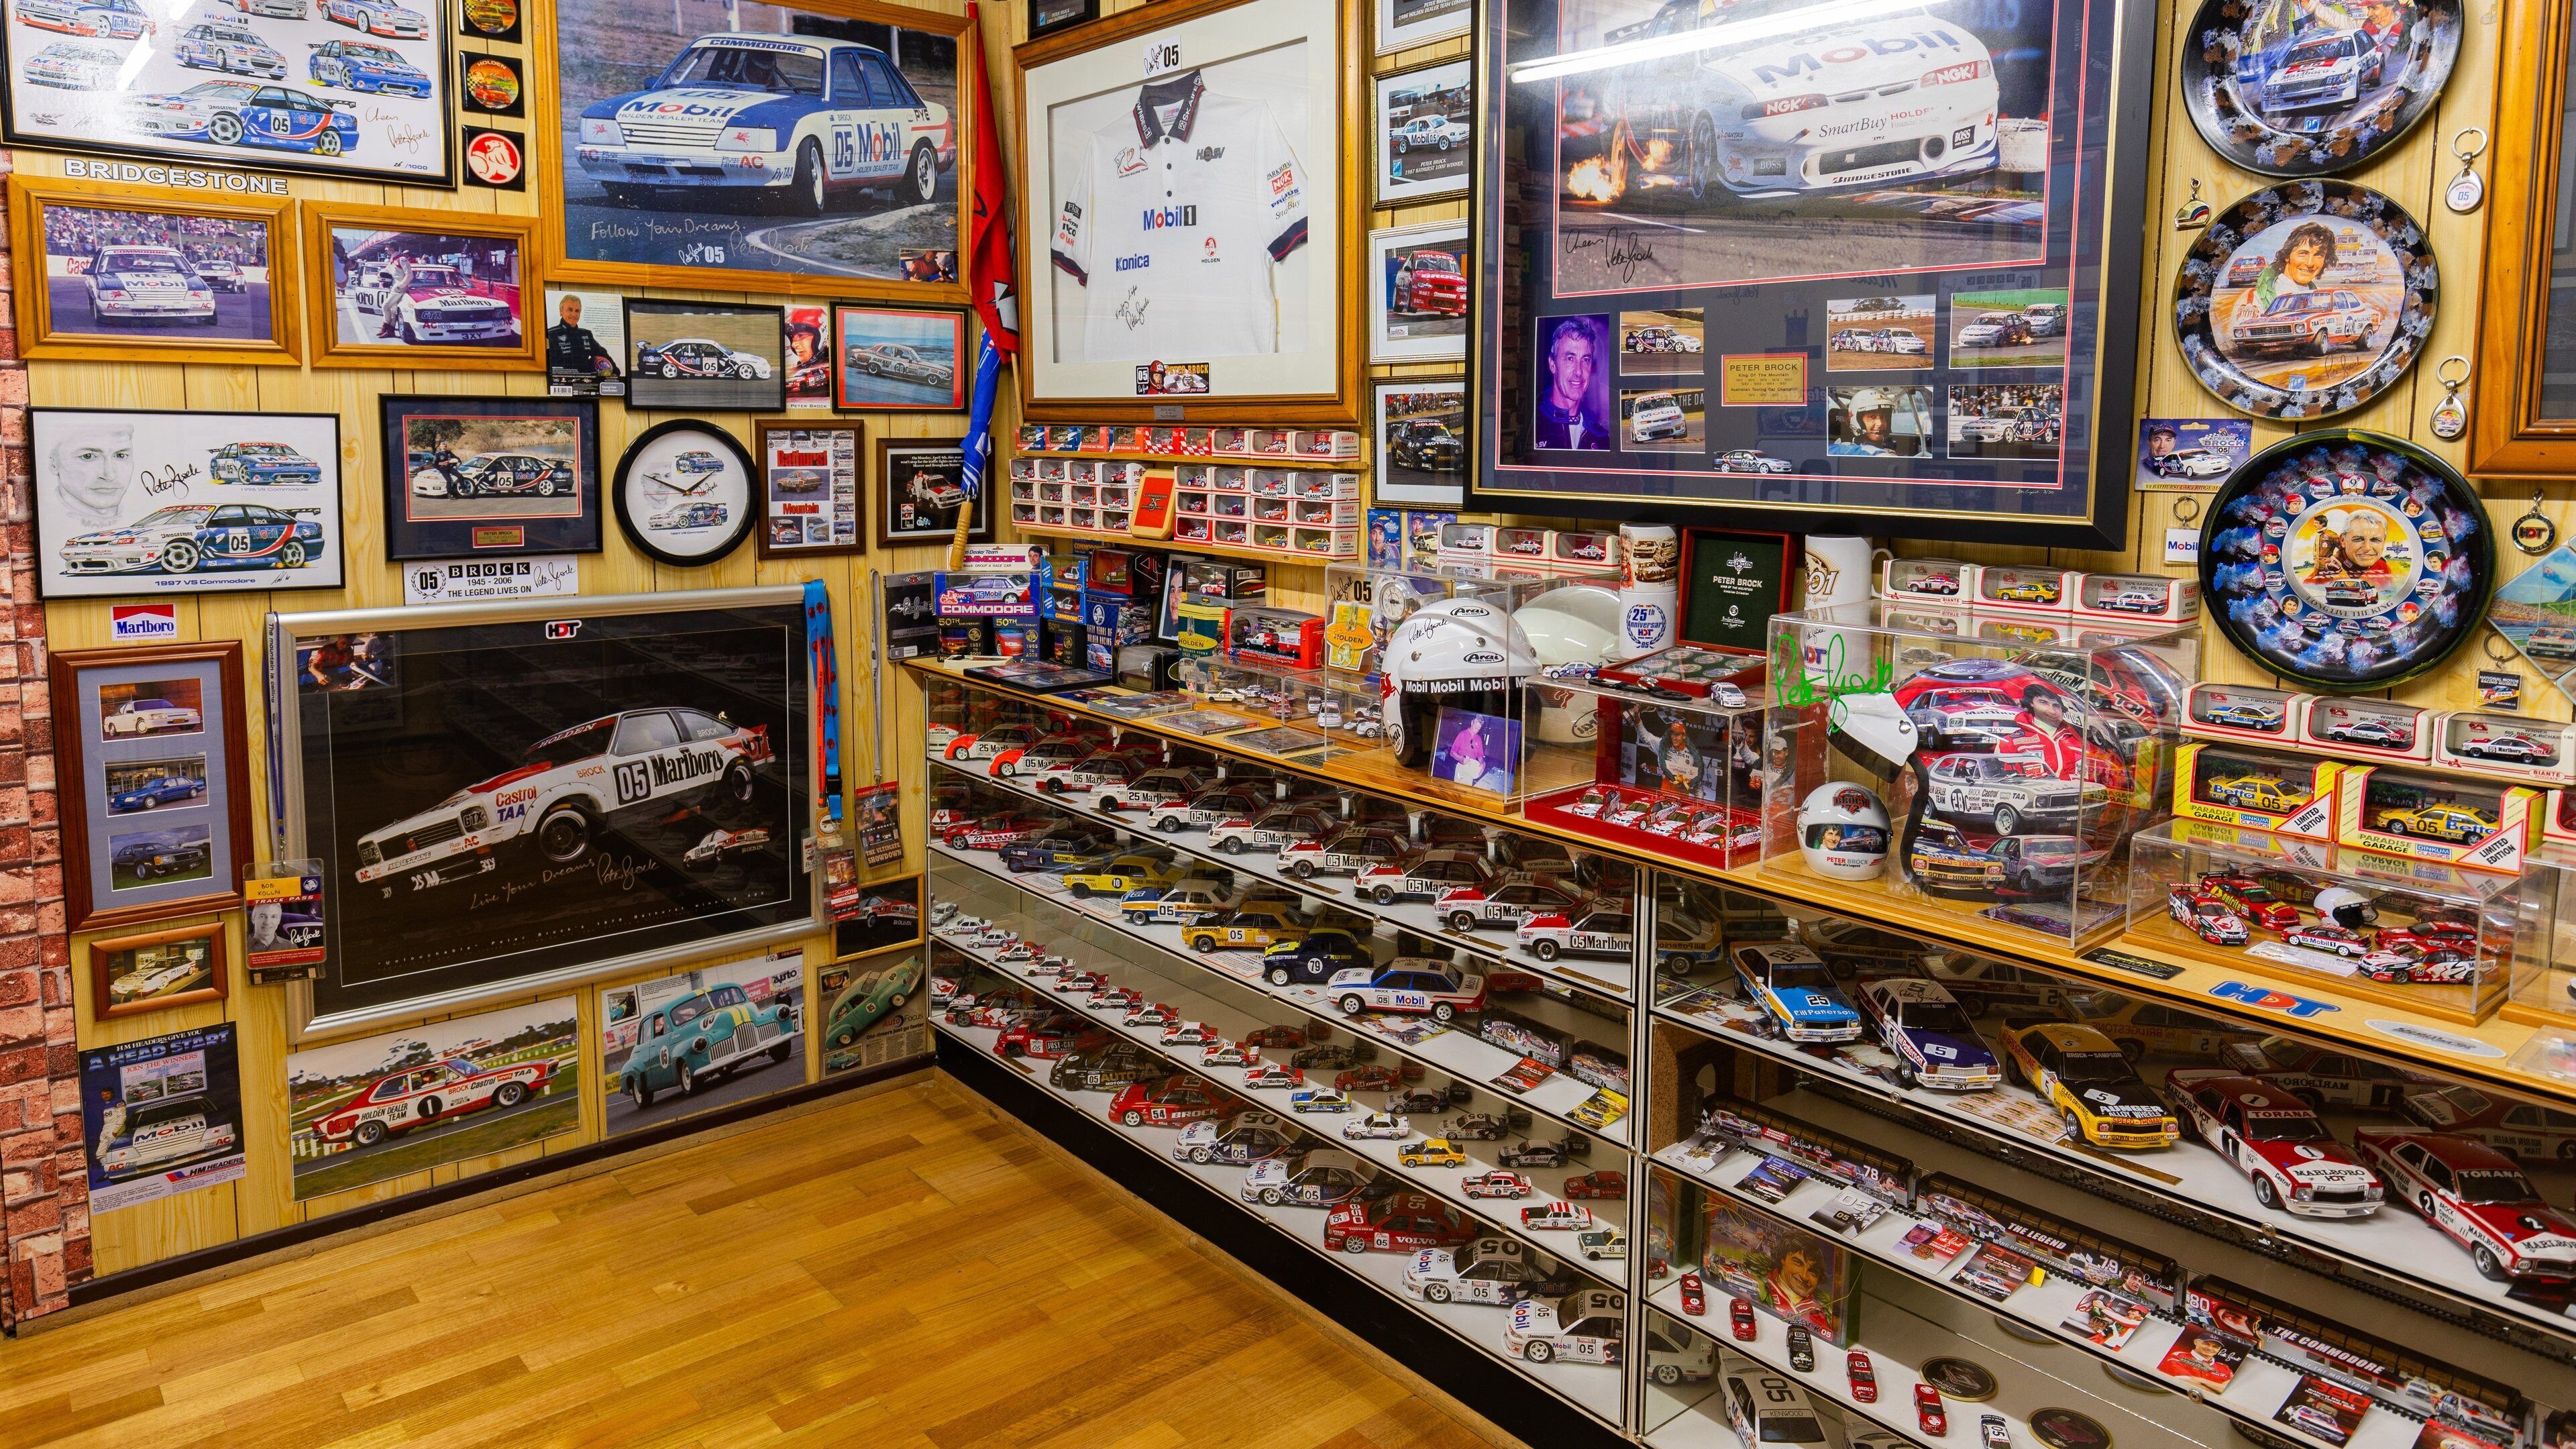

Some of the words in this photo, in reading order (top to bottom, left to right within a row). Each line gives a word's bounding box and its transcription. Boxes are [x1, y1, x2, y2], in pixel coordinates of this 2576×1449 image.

[710, 38, 806, 53] COMMODORE
[1752, 29, 1962, 85] Mobil
[623, 101, 735, 118] Mobil
[914, 109, 930, 121] PYE
[857, 123, 901, 163] Mobil
[65, 158, 288, 195] BRIDGESTONE
[1415, 164, 1434, 174] BATHURST
[1832, 167, 1913, 183] BRIDGESTONE
[591, 221, 639, 240] Follow
[1116, 254, 1150, 272] Konica
[439, 299, 492, 307] Marlboro
[1165, 366, 1186, 374] PETER
[1187, 364, 1209, 374] BROCK
[777, 450, 827, 467] Bathurst
[783, 503, 819, 515] Mountain
[2168, 541, 2199, 551] Mobil
[1713, 576, 1735, 586] PETER
[1737, 578, 1763, 588] BROCK
[465, 588, 494, 596] LEGEND
[941, 605, 1034, 614] COMMODORE
[2306, 597, 2328, 612] LONG
[2371, 601, 2393, 613] KING
[117, 620, 174, 635] Marlboro
[996, 618, 1017, 626] 50TH
[1627, 621, 1666, 629] Anniversary
[548, 623, 582, 637] HDT
[1334, 633, 1364, 645] HOLDEN
[1405, 680, 1428, 694] Mobil
[1430, 678, 1465, 693] Mobil
[1470, 678, 1508, 692] Mobil
[653, 747, 724, 789] Marlboro
[495, 785, 537, 808] Castrol
[1982, 789, 1998, 797] Castrol
[2214, 784, 2255, 799] Betta
[497, 803, 527, 822] TAA
[2191, 805, 2236, 818] PARADISE
[2194, 812, 2233, 822] GARAGE
[2241, 814, 2269, 822] DINKUM
[2294, 807, 2320, 826] LIMITED
[2300, 813, 2326, 833] EDITION
[865, 849, 875, 858] THE
[876, 842, 902, 855] ULTIMATE
[2363, 841, 2409, 854] GARAGE
[2479, 838, 2508, 858] LIMITED
[2487, 845, 2516, 865] EDITION
[1826, 855, 1847, 865] PETER
[1395, 995, 1425, 1005] Mobil
[132, 1036, 168, 1049] HEADERS
[168, 1033, 186, 1041] GIVE
[866, 1030, 892, 1040] Old-timers
[893, 1027, 902, 1035] just
[89, 1057, 105, 1072] A
[108, 1046, 166, 1067] HEAD
[171, 1030, 229, 1054] START
[127, 1065, 144, 1073] JOIN
[164, 1053, 198, 1064] WINNERS
[2061, 1087, 2073, 1101] CLASS
[2072, 1099, 2088, 1116] DRIVING
[361, 1108, 386, 1121] HOLDEN
[387, 1102, 409, 1117] DEALER
[388, 1111, 407, 1122] TEAM
[1171, 1108, 1219, 1119] BROCK
[2251, 1110, 2312, 1118] TORANA
[189, 1167, 206, 1176] HM
[207, 1157, 244, 1171] HEADERS
[1863, 1164, 1878, 1181] 78
[2459, 1170, 2522, 1179] TORANA
[1395, 1236, 1437, 1245] VOLVO
[2008, 1223, 2029, 1235] THE
[2027, 1231, 2067, 1249] LEGEND
[1515, 1301, 1530, 1330] Mobil
[2274, 1326, 2300, 1340] THE
[2298, 1336, 2385, 1374] COMMODORE
[2282, 1354, 2300, 1364] KING
[2314, 1366, 2326, 1374] THE
[2328, 1373, 2369, 1391] MOUNTAIN
